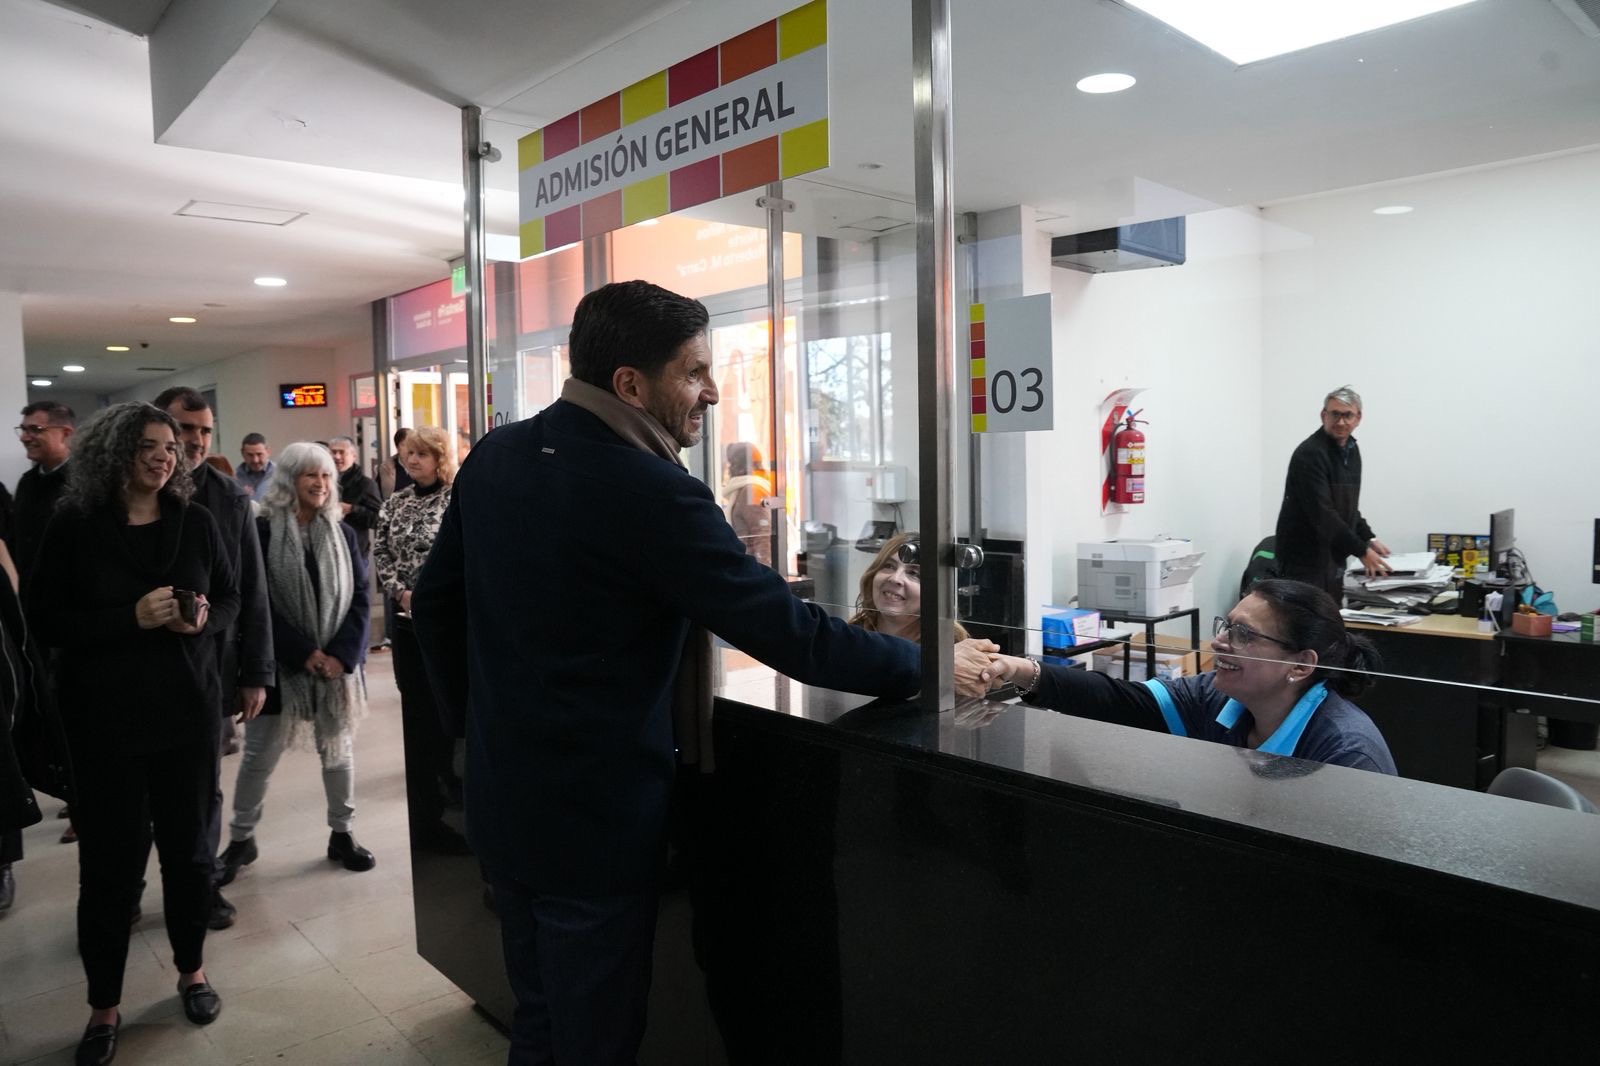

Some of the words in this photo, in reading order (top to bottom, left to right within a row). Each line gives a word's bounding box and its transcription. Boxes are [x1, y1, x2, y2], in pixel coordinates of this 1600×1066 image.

[535, 135, 647, 208] ADMISIÓN
[655, 81, 795, 161] GENERAL
[991, 367, 1044, 414] 03
